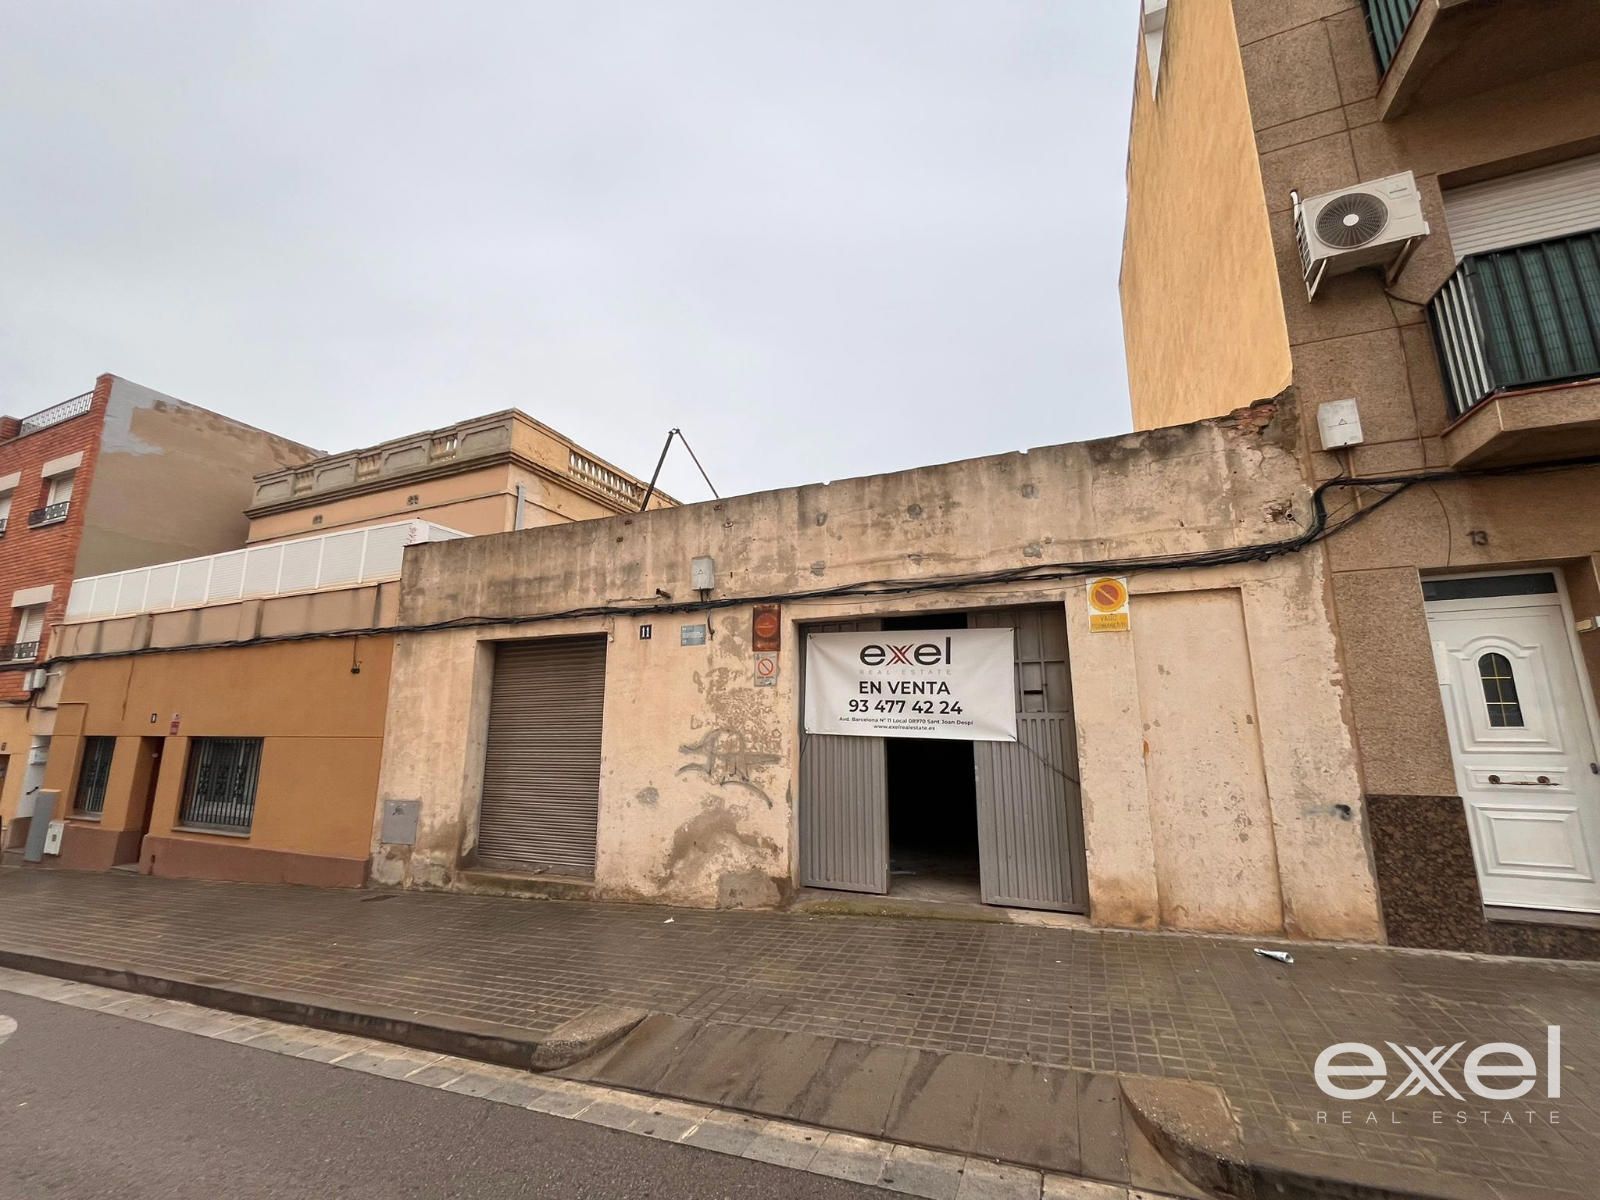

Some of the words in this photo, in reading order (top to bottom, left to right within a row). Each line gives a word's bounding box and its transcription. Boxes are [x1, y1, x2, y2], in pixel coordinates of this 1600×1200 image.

[1465, 530, 1488, 546] 13
[641, 626, 650, 637] 11
[860, 637, 951, 666] exel
[859, 681, 882, 694] EN
[887, 681, 950, 695] VENTA
[849, 699, 869, 712] 93
[874, 700, 906, 713] 477
[911, 700, 934, 714] 42
[939, 701, 963, 715] 24
